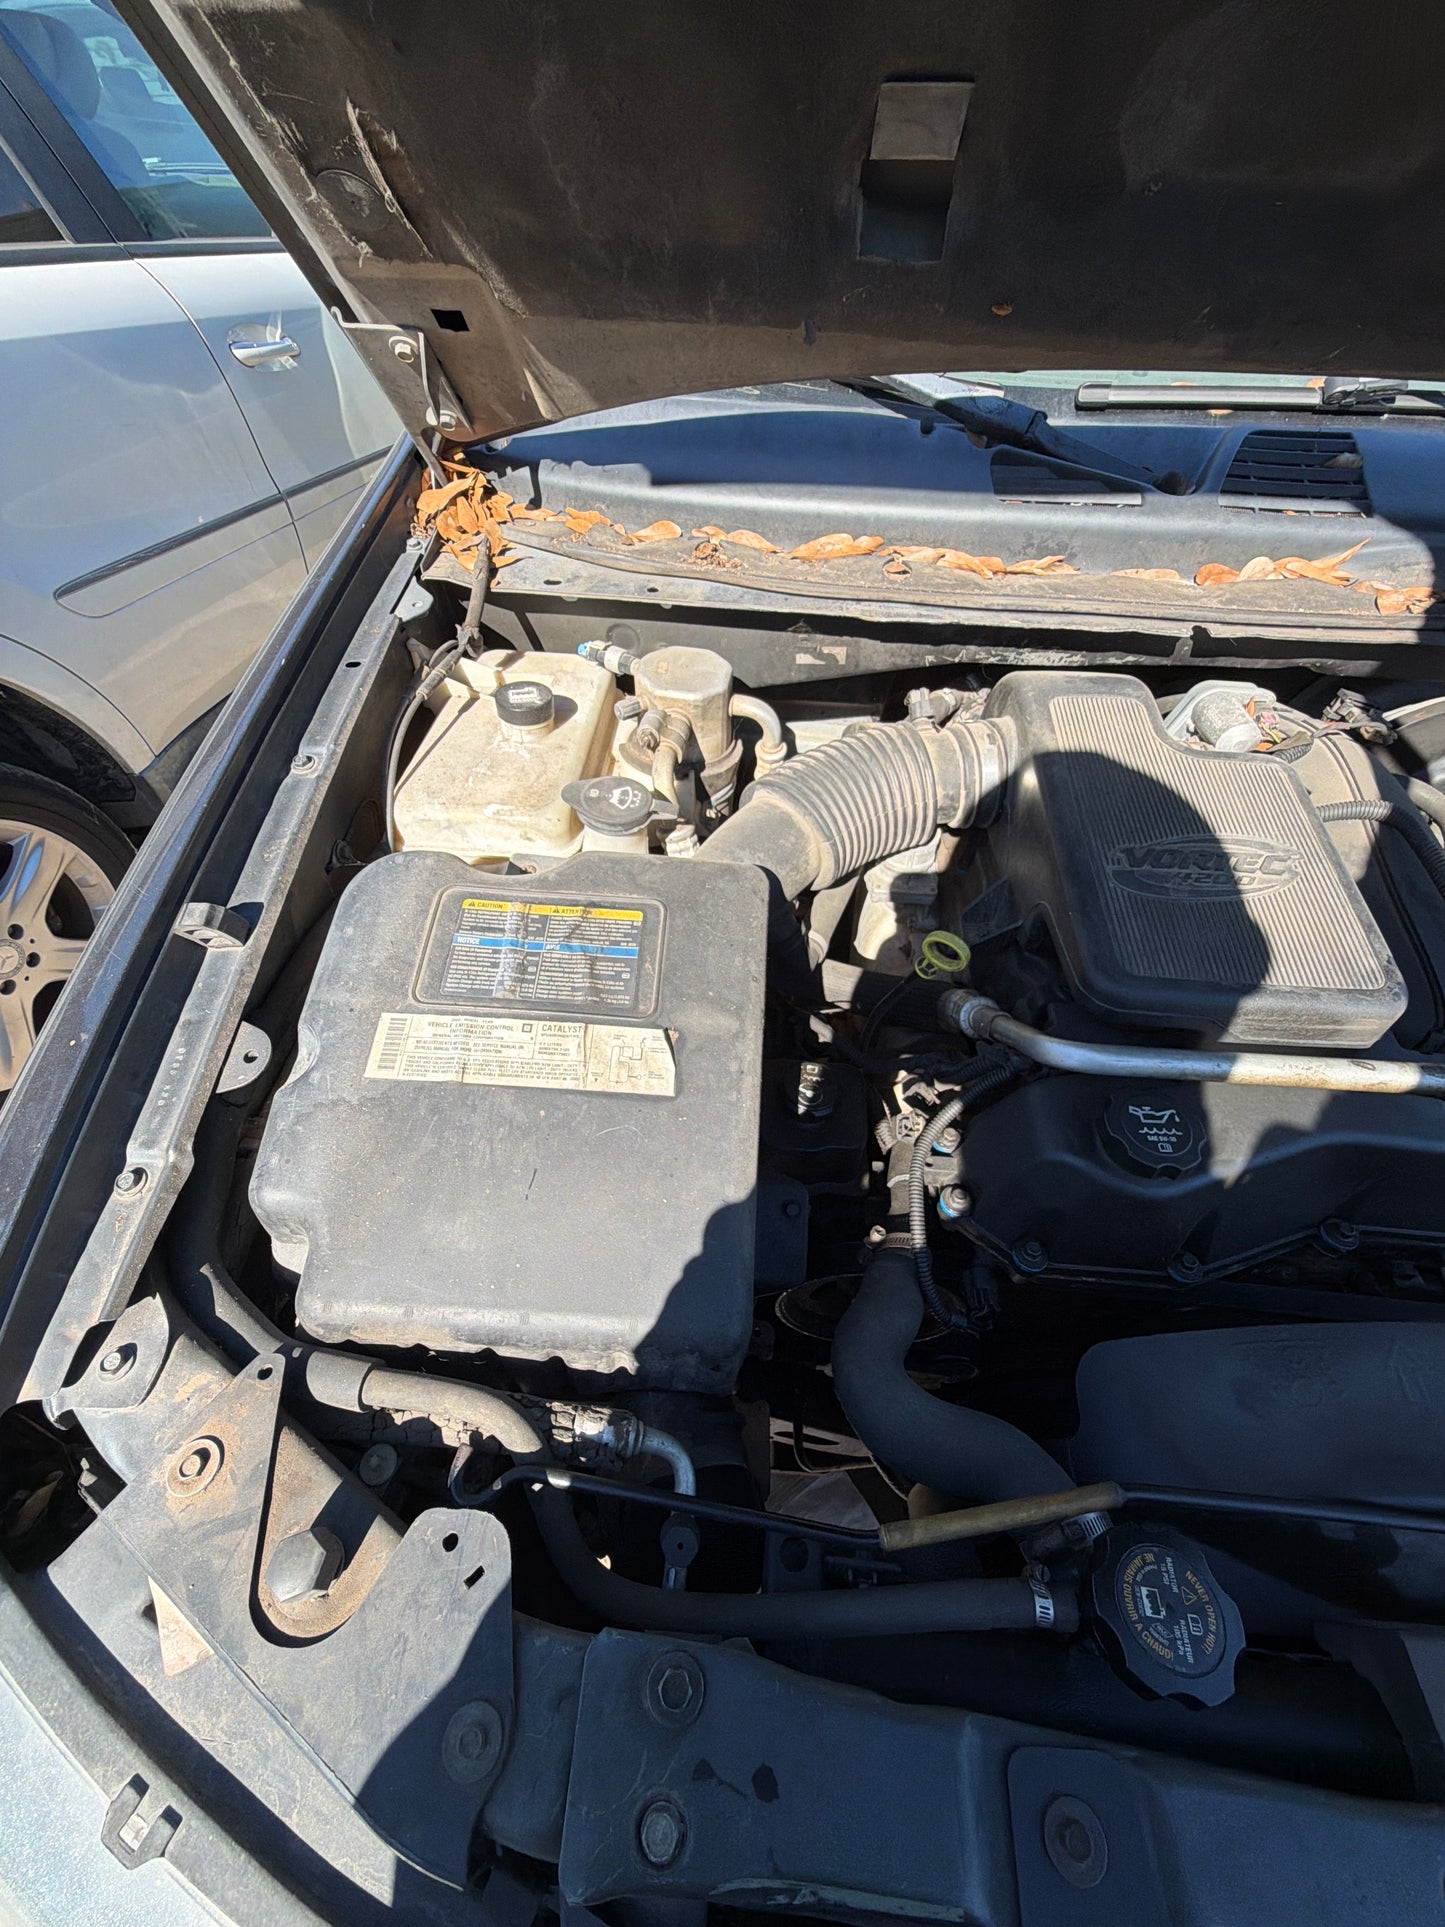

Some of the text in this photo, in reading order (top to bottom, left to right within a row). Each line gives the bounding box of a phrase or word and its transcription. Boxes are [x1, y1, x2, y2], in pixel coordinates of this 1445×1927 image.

[457, 936, 480, 945] NOTICE
[427, 1021, 514, 1032] VEHICLE EMISSION CONTROL
[449, 1028, 493, 1036] INFORMATION
[541, 1023, 583, 1033] CATALYST
[1145, 1553, 1155, 1563] NE
[1123, 1557, 1143, 1584] JAMAIS
[1160, 1563, 1170, 1585] 15 PSI
[1165, 1556, 1179, 1593] RADIATOR
[1122, 1584, 1138, 1621] OUVRIR
[1185, 1571, 1209, 1603] NEVER
[1205, 1604, 1217, 1634] OPEN
[1135, 1623, 1143, 1632] A
[1179, 1619, 1194, 1664] RADIATEUR
